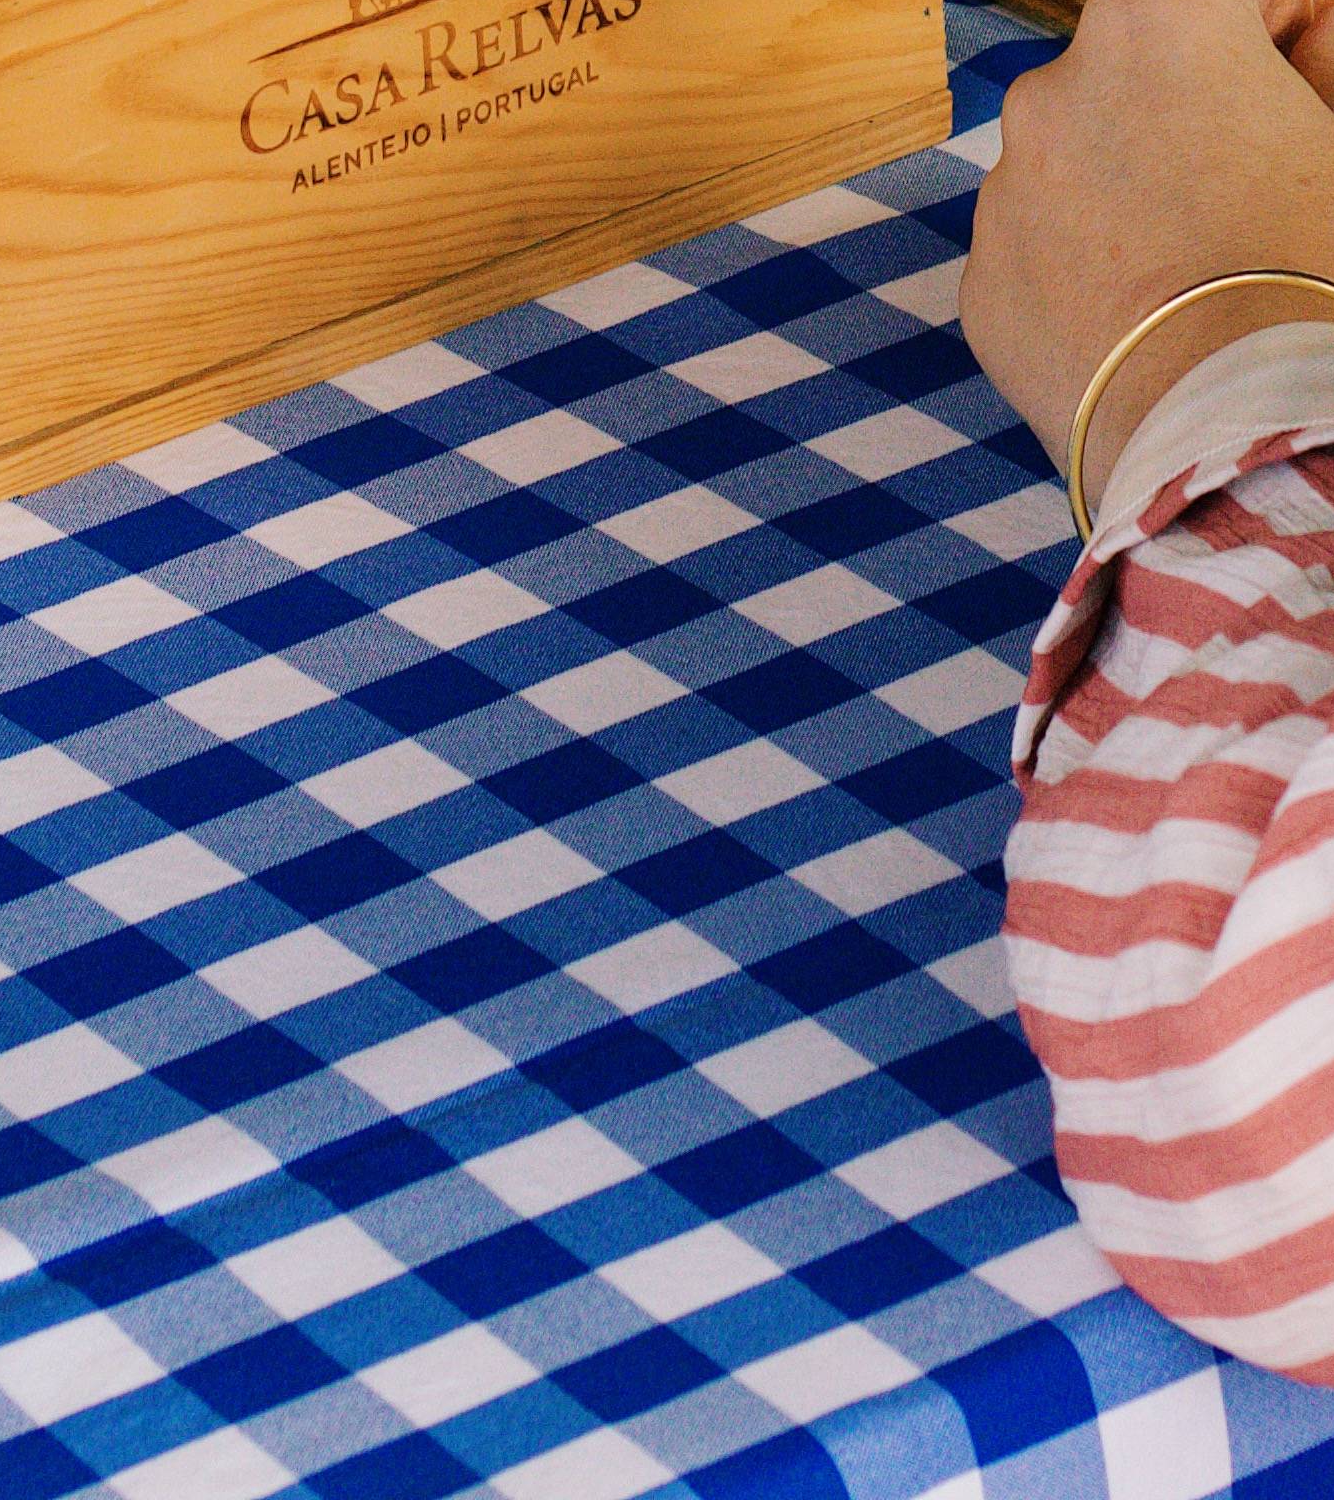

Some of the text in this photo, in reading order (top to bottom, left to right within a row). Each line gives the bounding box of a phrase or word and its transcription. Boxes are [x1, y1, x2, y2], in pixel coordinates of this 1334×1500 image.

[239, 60, 410, 155] CASA
[291, 120, 433, 194] ALENTEJO
[456, 59, 601, 134] PORTUGAL
